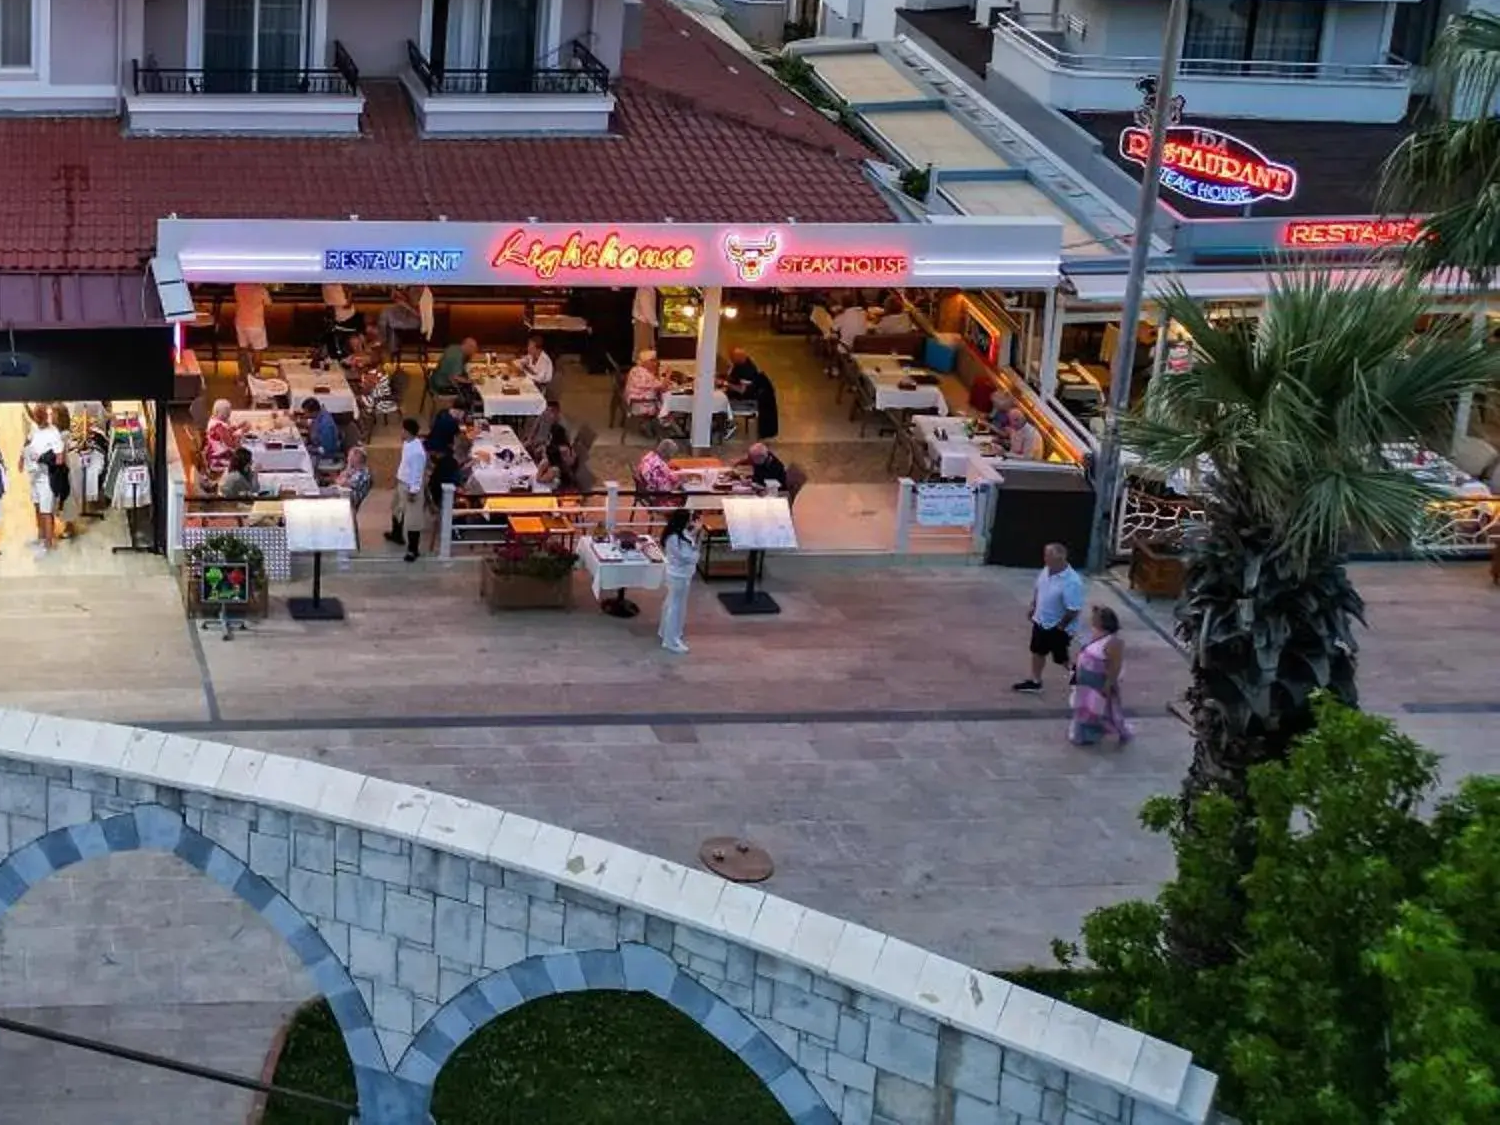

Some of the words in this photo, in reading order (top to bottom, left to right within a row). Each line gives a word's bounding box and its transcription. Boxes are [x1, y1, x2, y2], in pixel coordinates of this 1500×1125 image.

[1128, 135, 1290, 192] RSTAURANT
[1197, 183, 1252, 202] HOUSE
[325, 250, 462, 272] RESTAURANT
[491, 229, 695, 278] Lighthouse
[777, 255, 837, 274] STEAK
[840, 256, 908, 274] HOUSE
